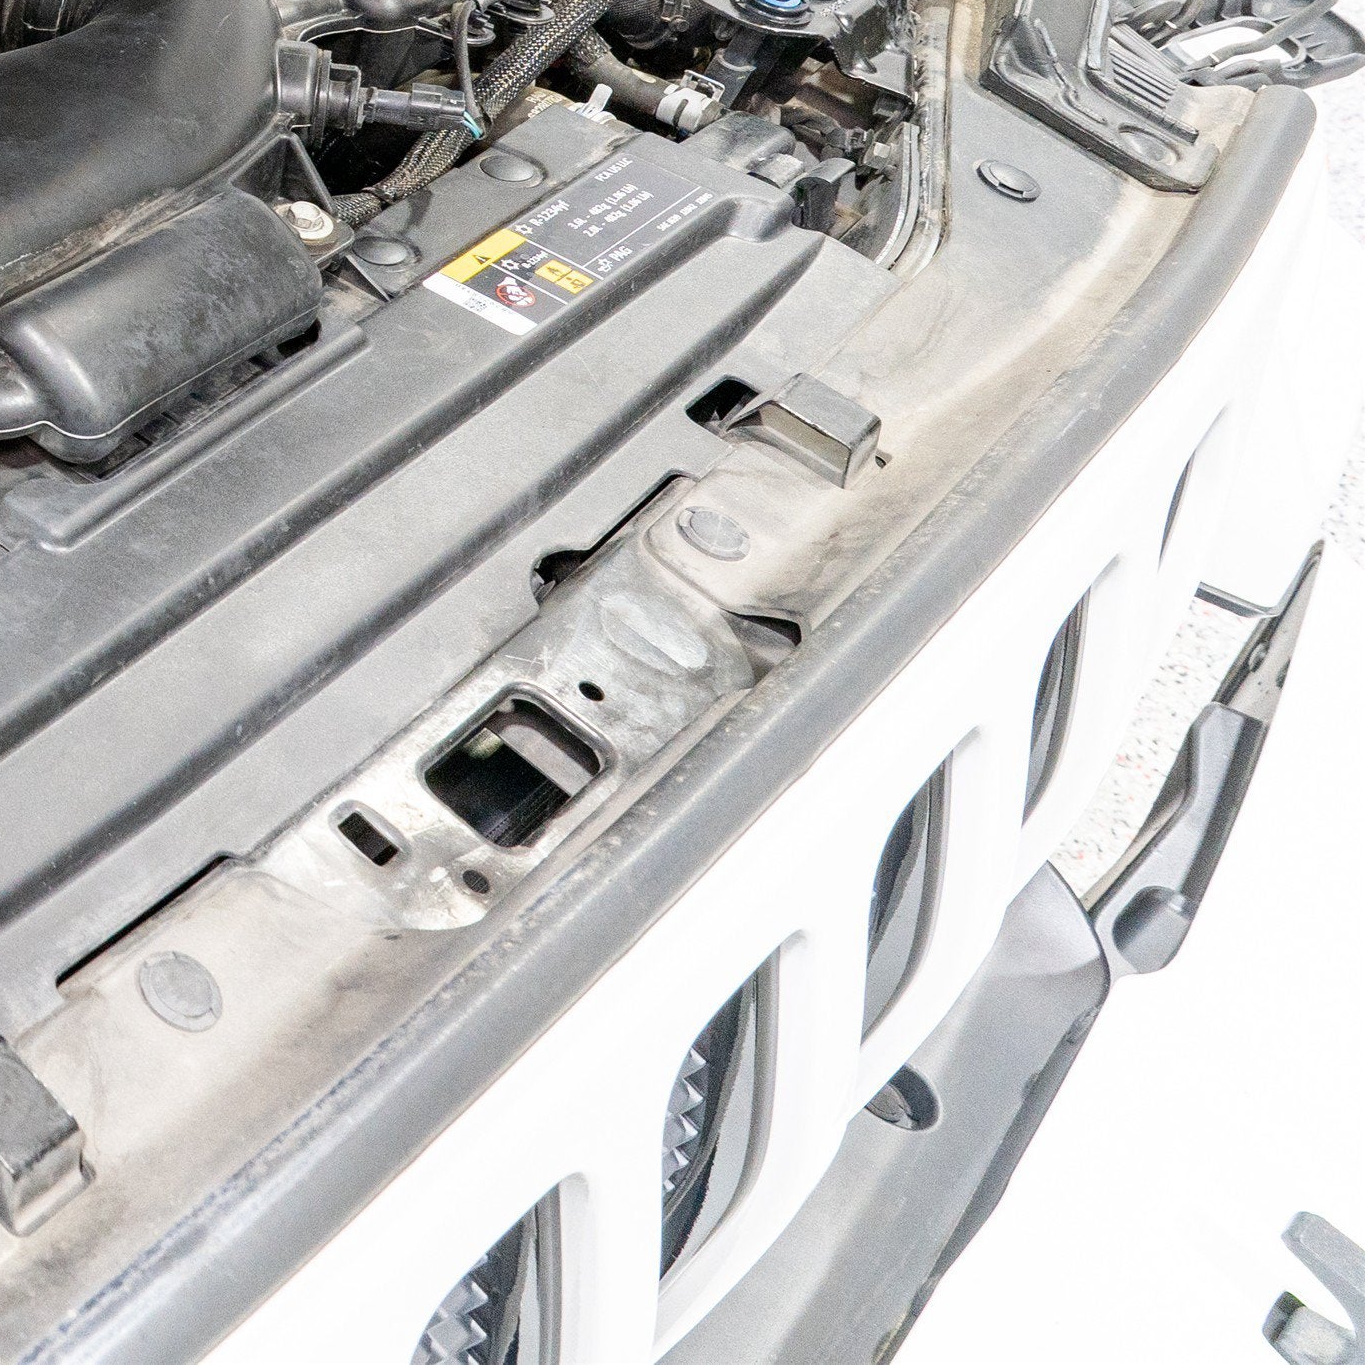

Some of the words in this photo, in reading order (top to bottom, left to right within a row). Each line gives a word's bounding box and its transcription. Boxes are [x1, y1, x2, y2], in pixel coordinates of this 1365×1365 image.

[594, 170, 614, 183] FCA
[529, 199, 570, 227] R-1234yf
[608, 245, 633, 262] PAG
